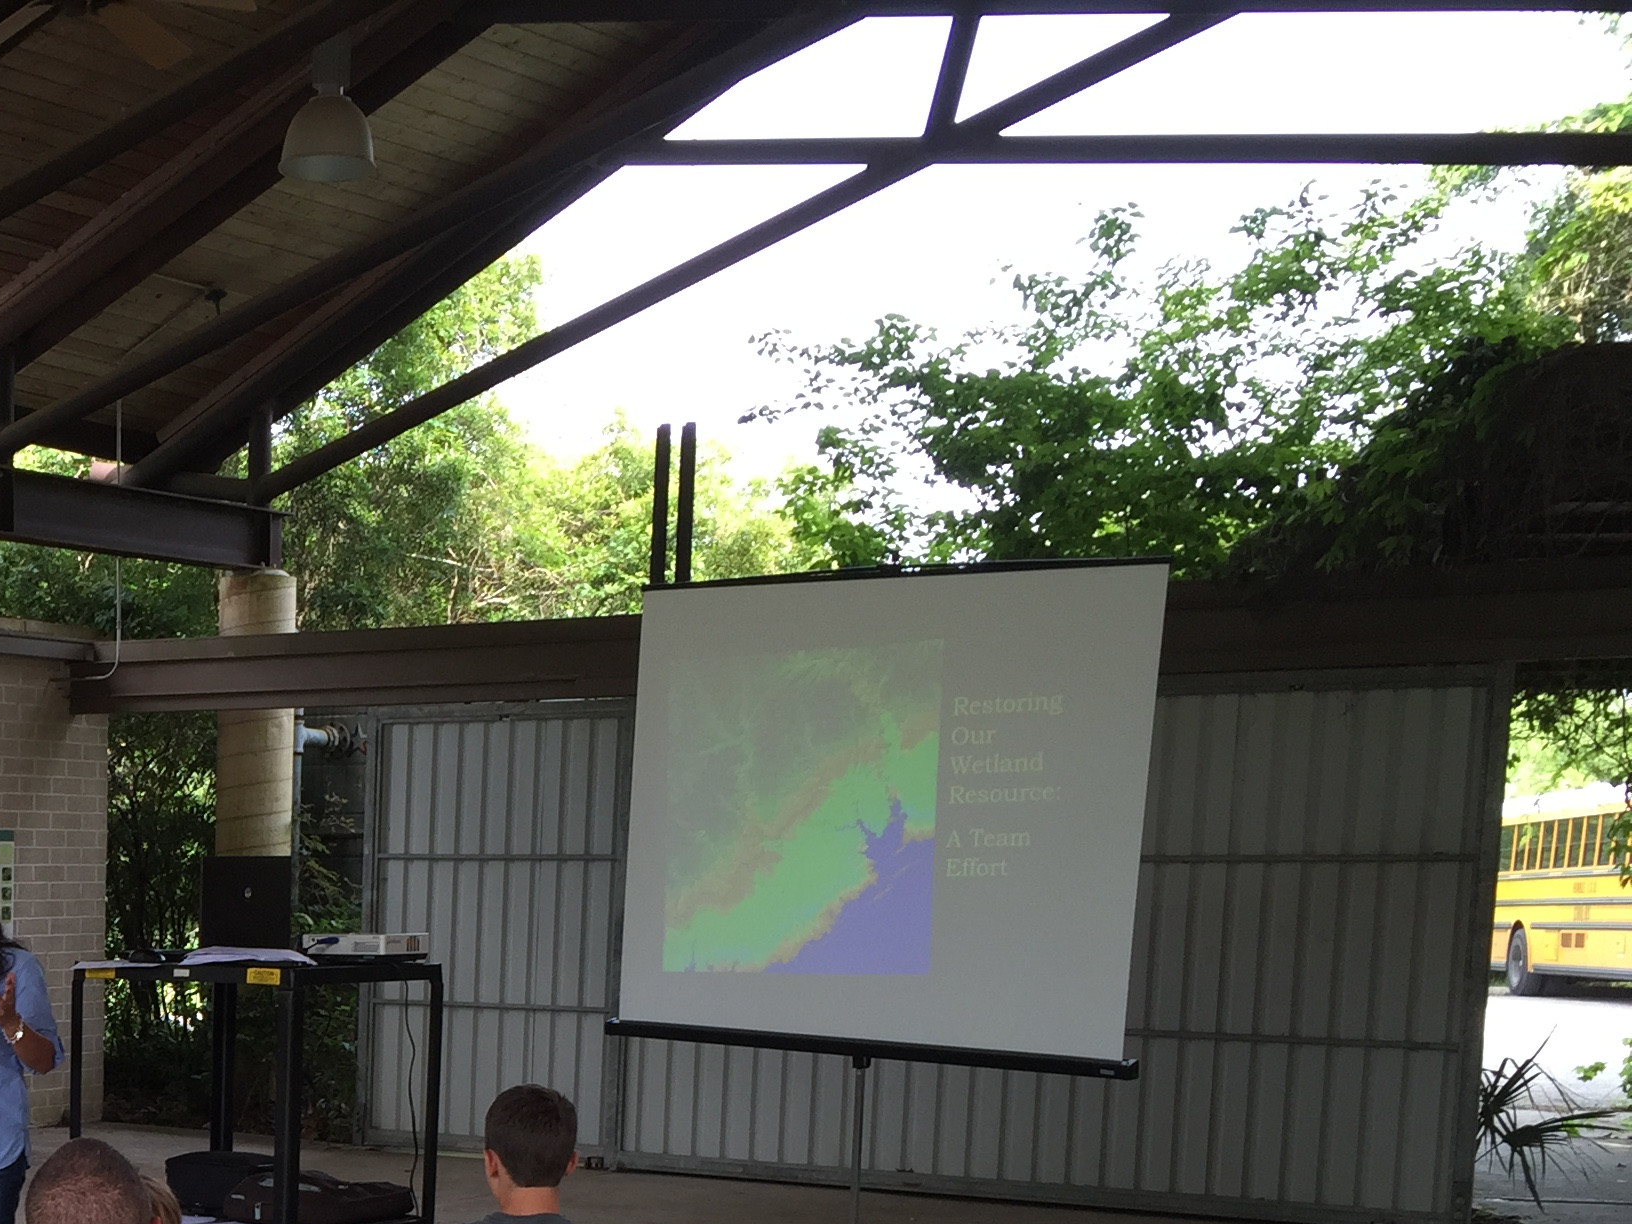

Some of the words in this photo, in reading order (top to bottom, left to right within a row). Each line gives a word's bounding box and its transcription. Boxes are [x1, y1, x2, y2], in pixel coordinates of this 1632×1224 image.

[953, 692, 1064, 716] Restoring
[951, 726, 997, 745] Our
[950, 751, 1044, 775] Wetland
[949, 785, 1063, 804] Resource:
[946, 829, 961, 848] A
[969, 828, 1031, 848] Team
[946, 857, 1009, 877] Effort
